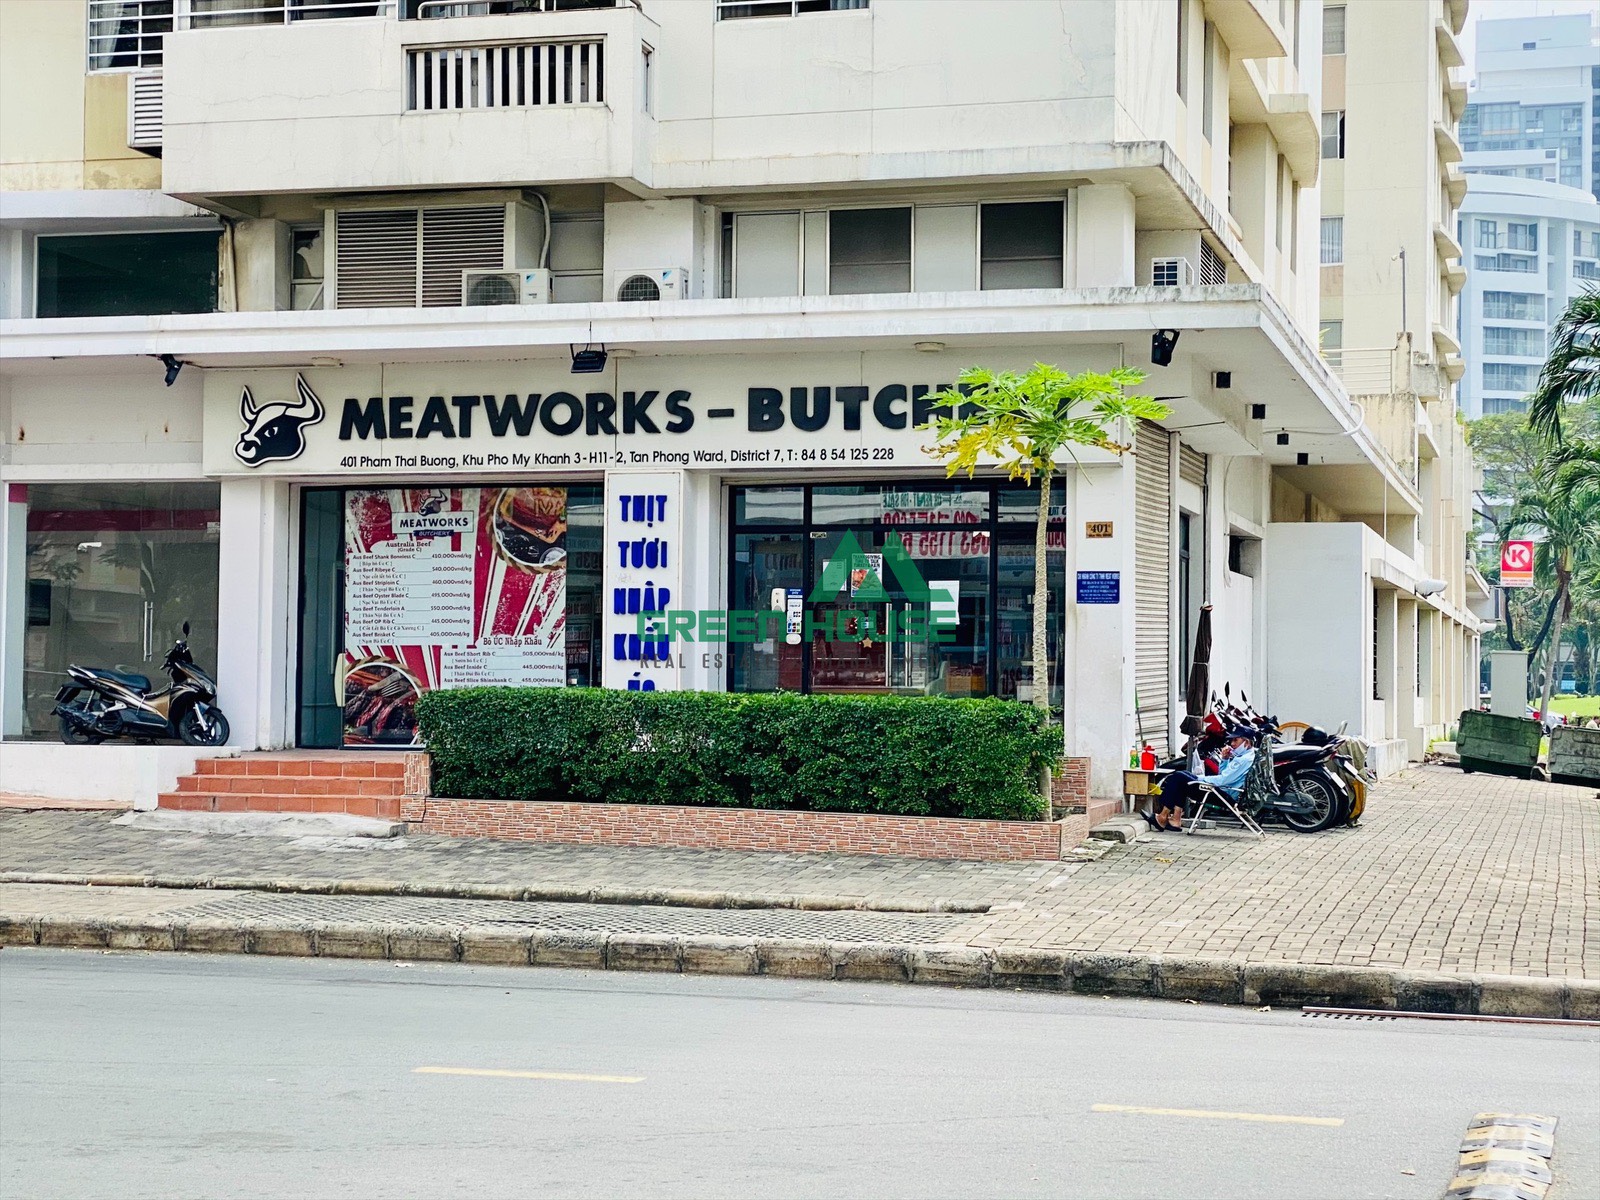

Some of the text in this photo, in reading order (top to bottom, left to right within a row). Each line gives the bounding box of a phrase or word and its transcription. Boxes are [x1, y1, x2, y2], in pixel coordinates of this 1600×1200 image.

[338, 390, 694, 440] MEATWORKS
[748, 384, 1068, 432] BUTCHE
[340, 456, 357, 468] 401
[360, 456, 392, 468] Pham
[395, 456, 417, 466] Thai
[420, 455, 459, 468] Buong,
[462, 454, 484, 466] Khu
[488, 454, 509, 466] Pho
[512, 454, 530, 467] My
[535, 453, 570, 464] Khanh
[630, 451, 649, 462] Tan
[653, 450, 690, 464] Phong
[694, 450, 727, 462] Ward,
[730, 450, 770, 462] District
[774, 450, 784, 462] 7,
[788, 450, 798, 460] T:
[802, 449, 816, 460] 84
[820, 449, 827, 460] 8
[830, 449, 846, 460] 54
[850, 448, 869, 460] 125
[872, 448, 894, 460] 228
[400, 518, 468, 528] MEATWORKS
[620, 495, 668, 528] THỊT
[1091, 524, 1108, 533] 401
[618, 538, 668, 568] TƯƠI
[1511, 549, 1526, 566] K
[614, 580, 670, 620] NHẬP
